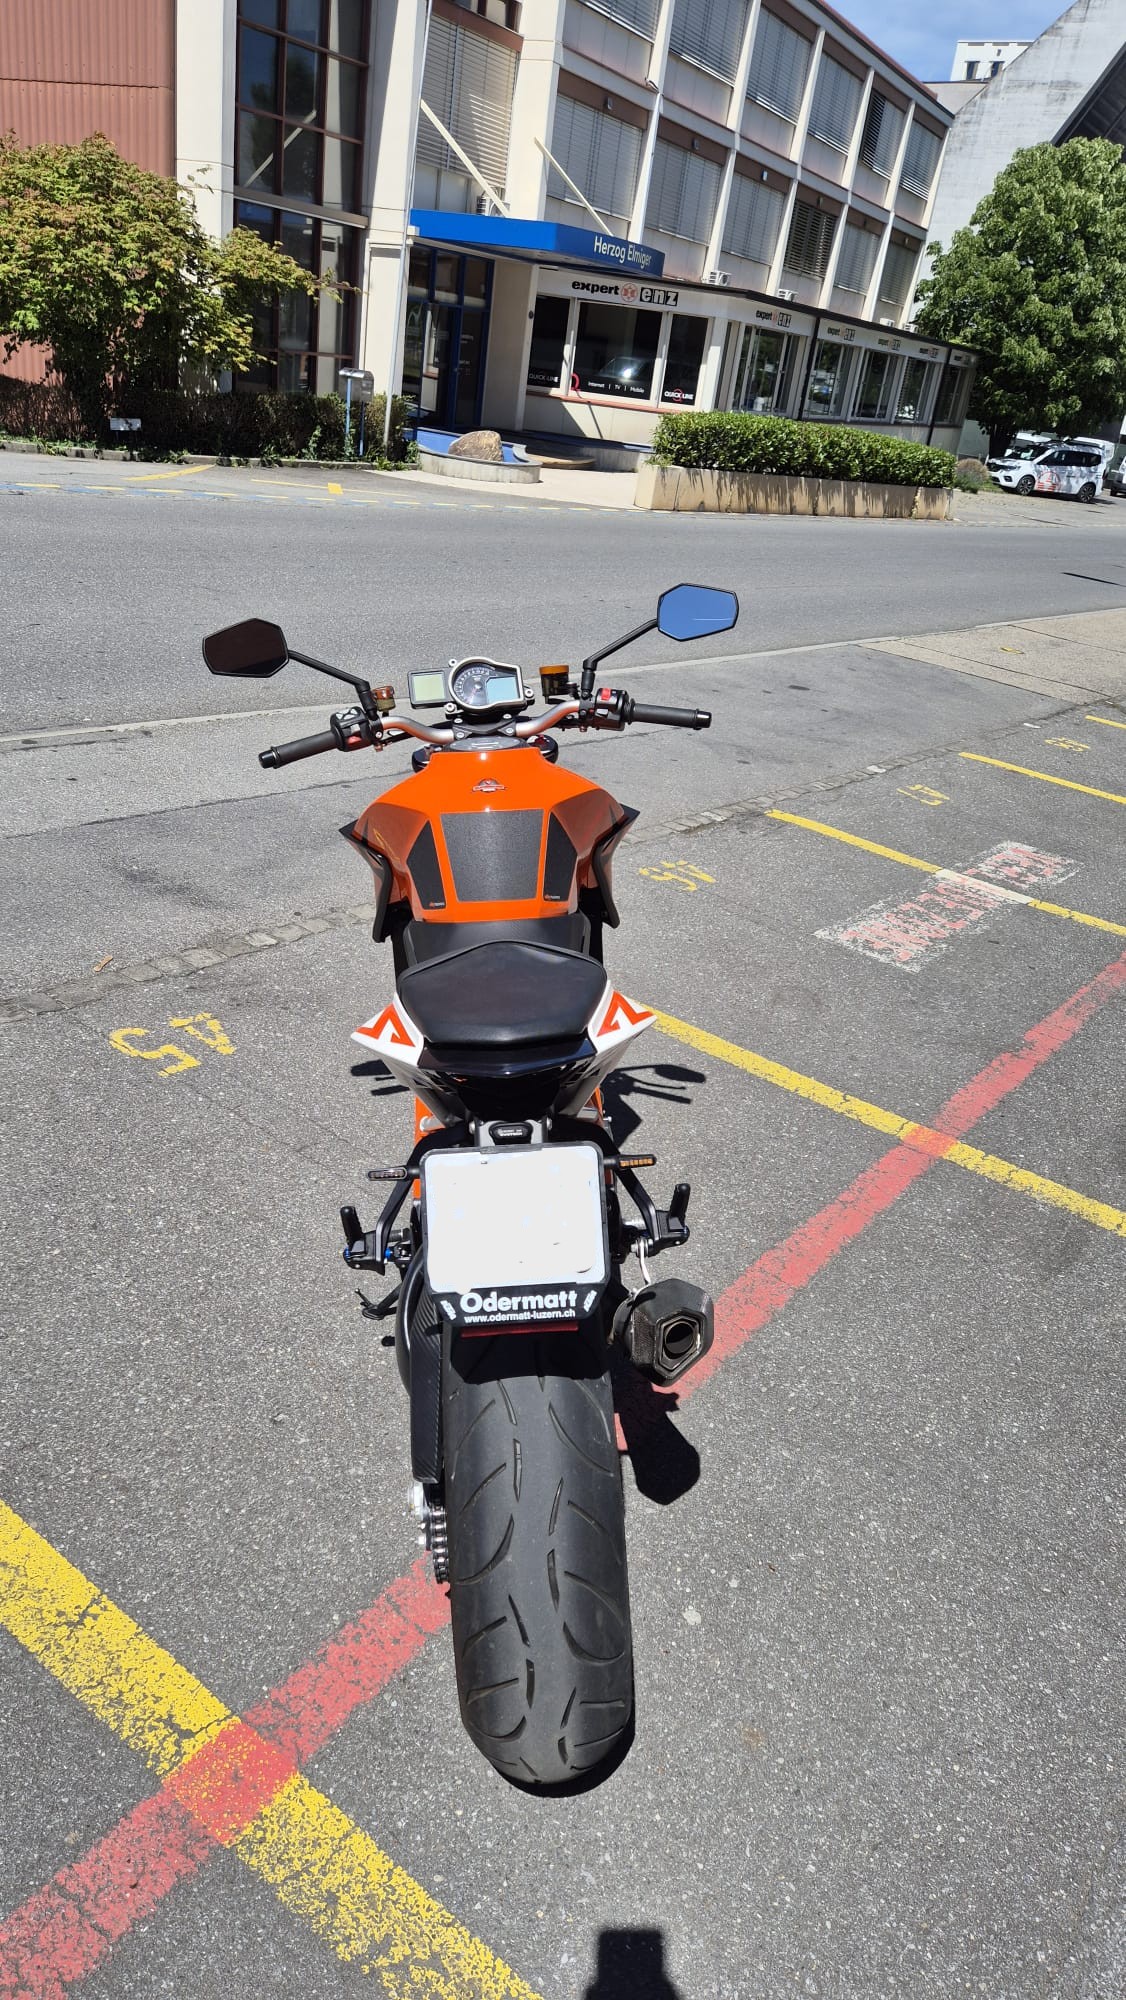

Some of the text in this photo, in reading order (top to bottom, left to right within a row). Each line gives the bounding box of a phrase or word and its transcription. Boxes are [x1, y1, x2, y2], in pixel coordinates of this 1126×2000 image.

[594, 235, 653, 269] Herzog Elmiger
[571, 280, 679, 307] expert enz
[460, 1290, 578, 1313] Odermatt
[463, 1308, 576, 1323] www.odermatt-luzern.ch
